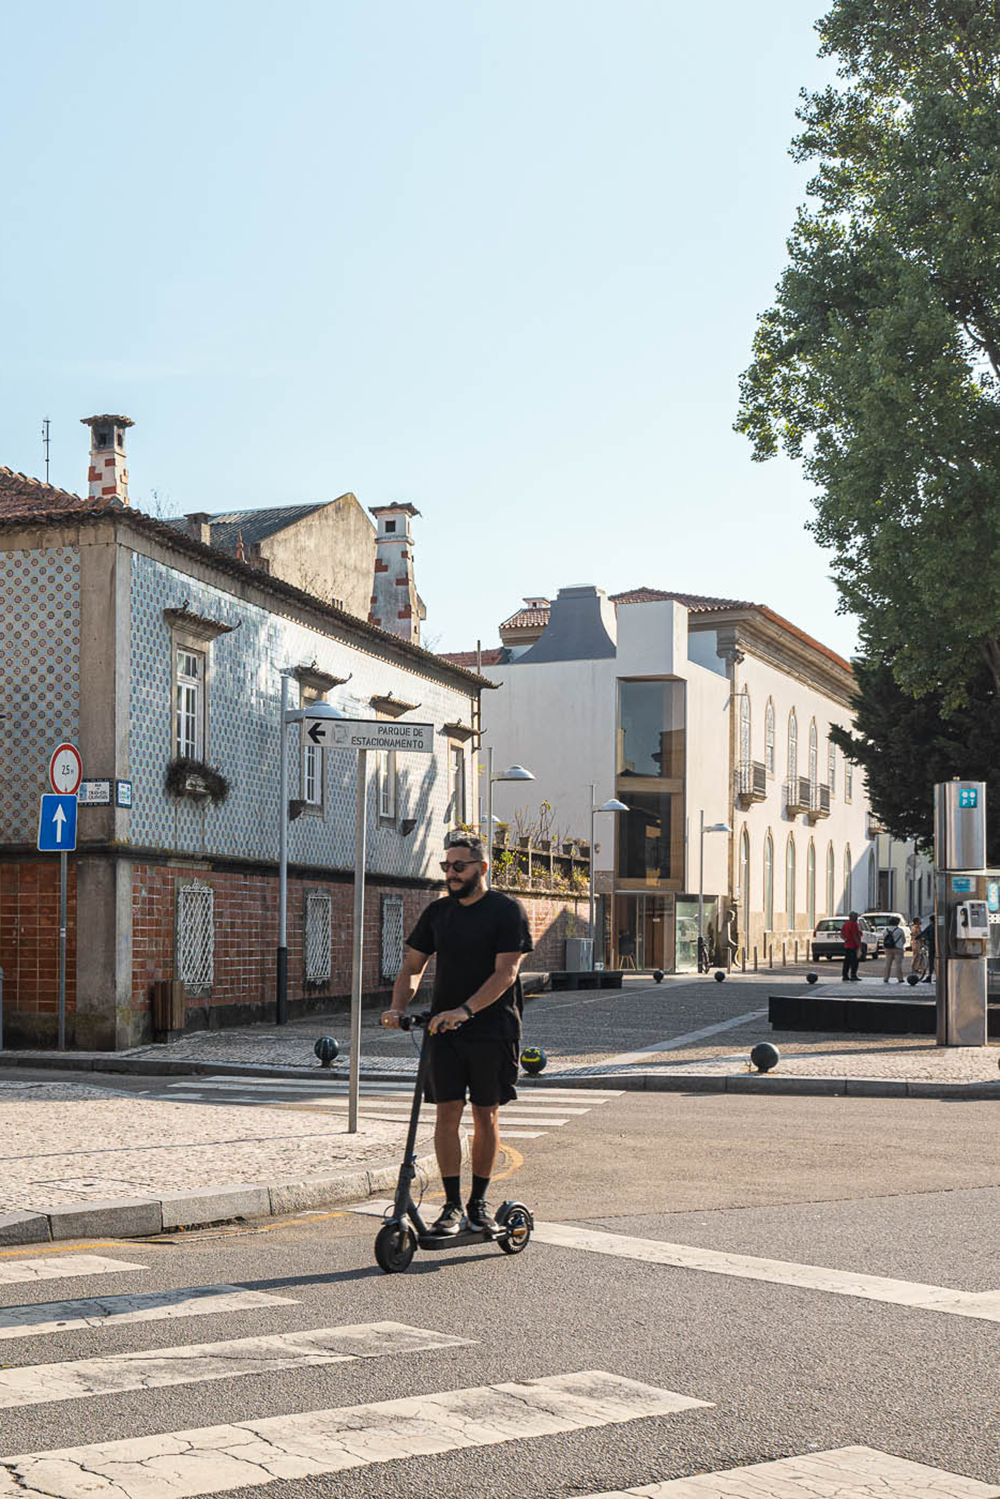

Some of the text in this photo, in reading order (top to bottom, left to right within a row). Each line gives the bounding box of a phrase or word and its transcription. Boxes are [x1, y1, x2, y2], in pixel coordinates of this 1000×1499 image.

[377, 726, 424, 737] PARQUE DE
[351, 736, 424, 749] ESTACIONAMENTO
